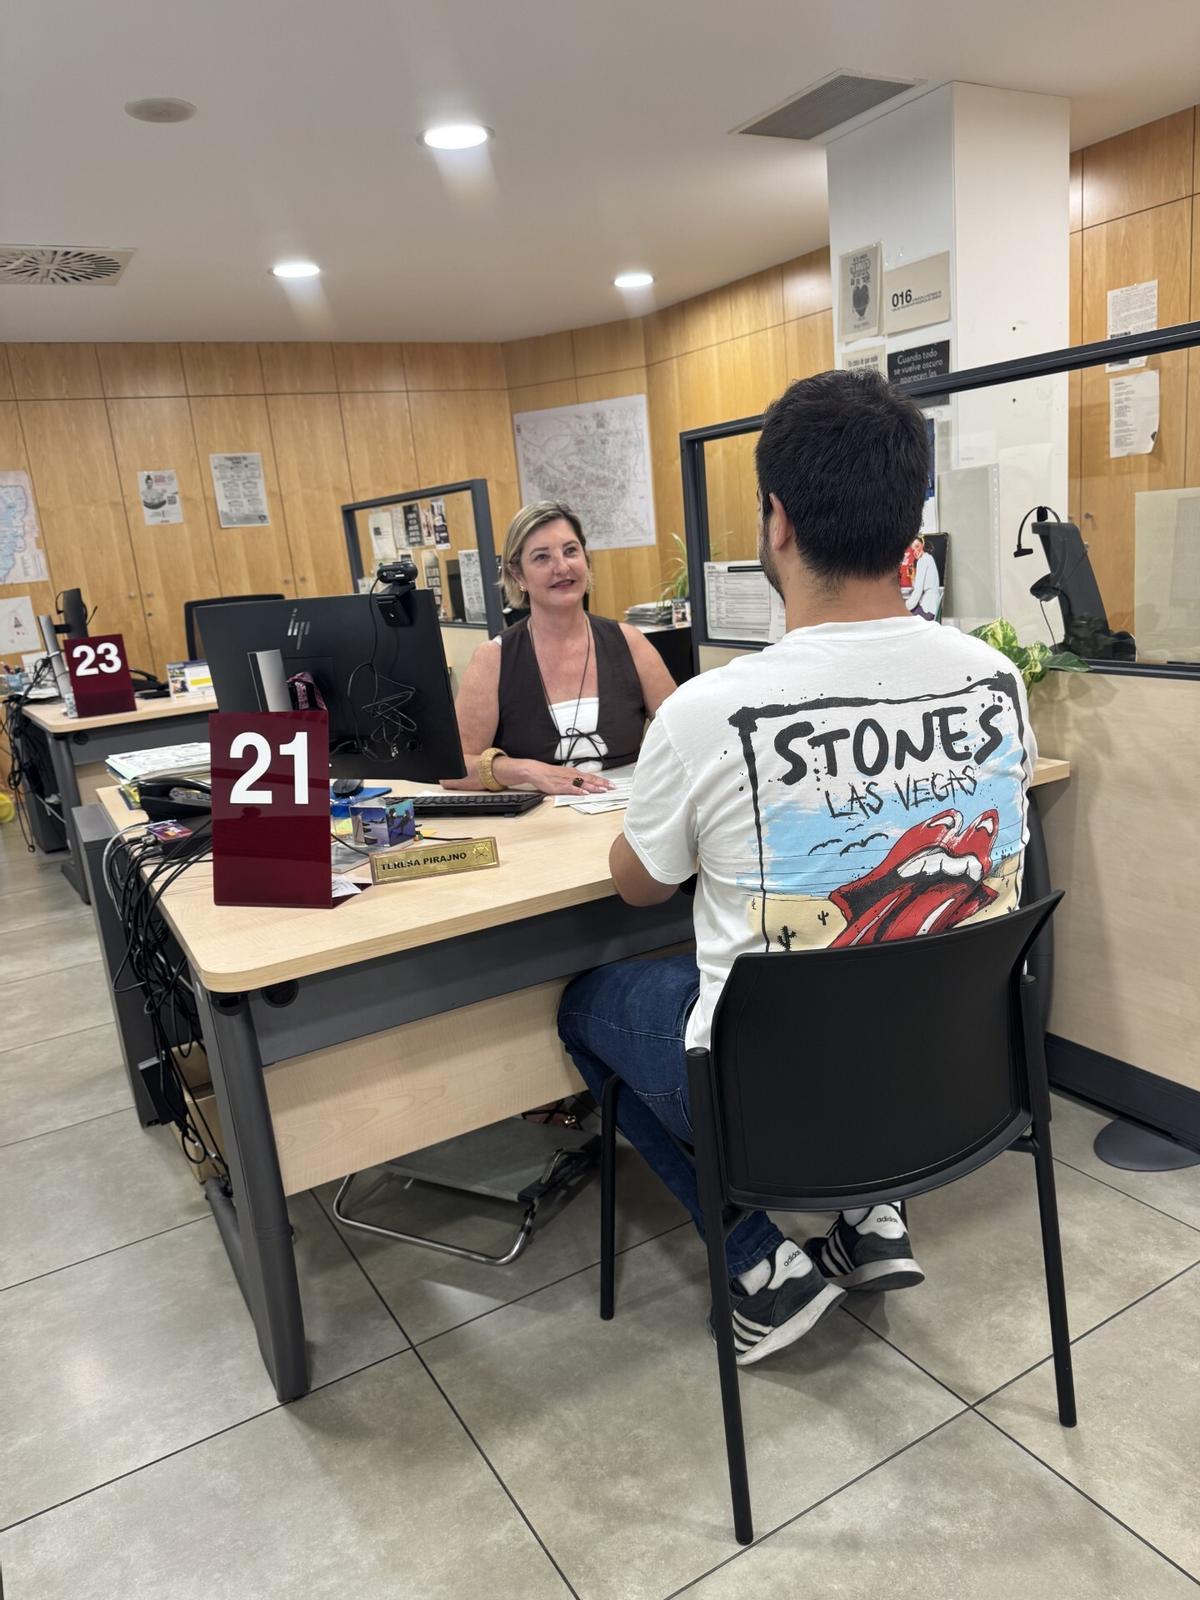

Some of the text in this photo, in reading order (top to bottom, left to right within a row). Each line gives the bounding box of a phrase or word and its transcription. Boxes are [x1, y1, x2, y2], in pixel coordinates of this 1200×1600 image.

[892, 289, 912, 308] 016
[897, 348, 938, 365] Cuando todo
[894, 359, 944, 376] se vuelve oscuro
[72, 642, 122, 677] 23
[774, 705, 1004, 786] STONES
[229, 731, 310, 805] 21
[825, 765, 978, 819] LAS VEGAS
[381, 852, 466, 870] TERESA PIRAJNO
[783, 1250, 802, 1267] adidas
